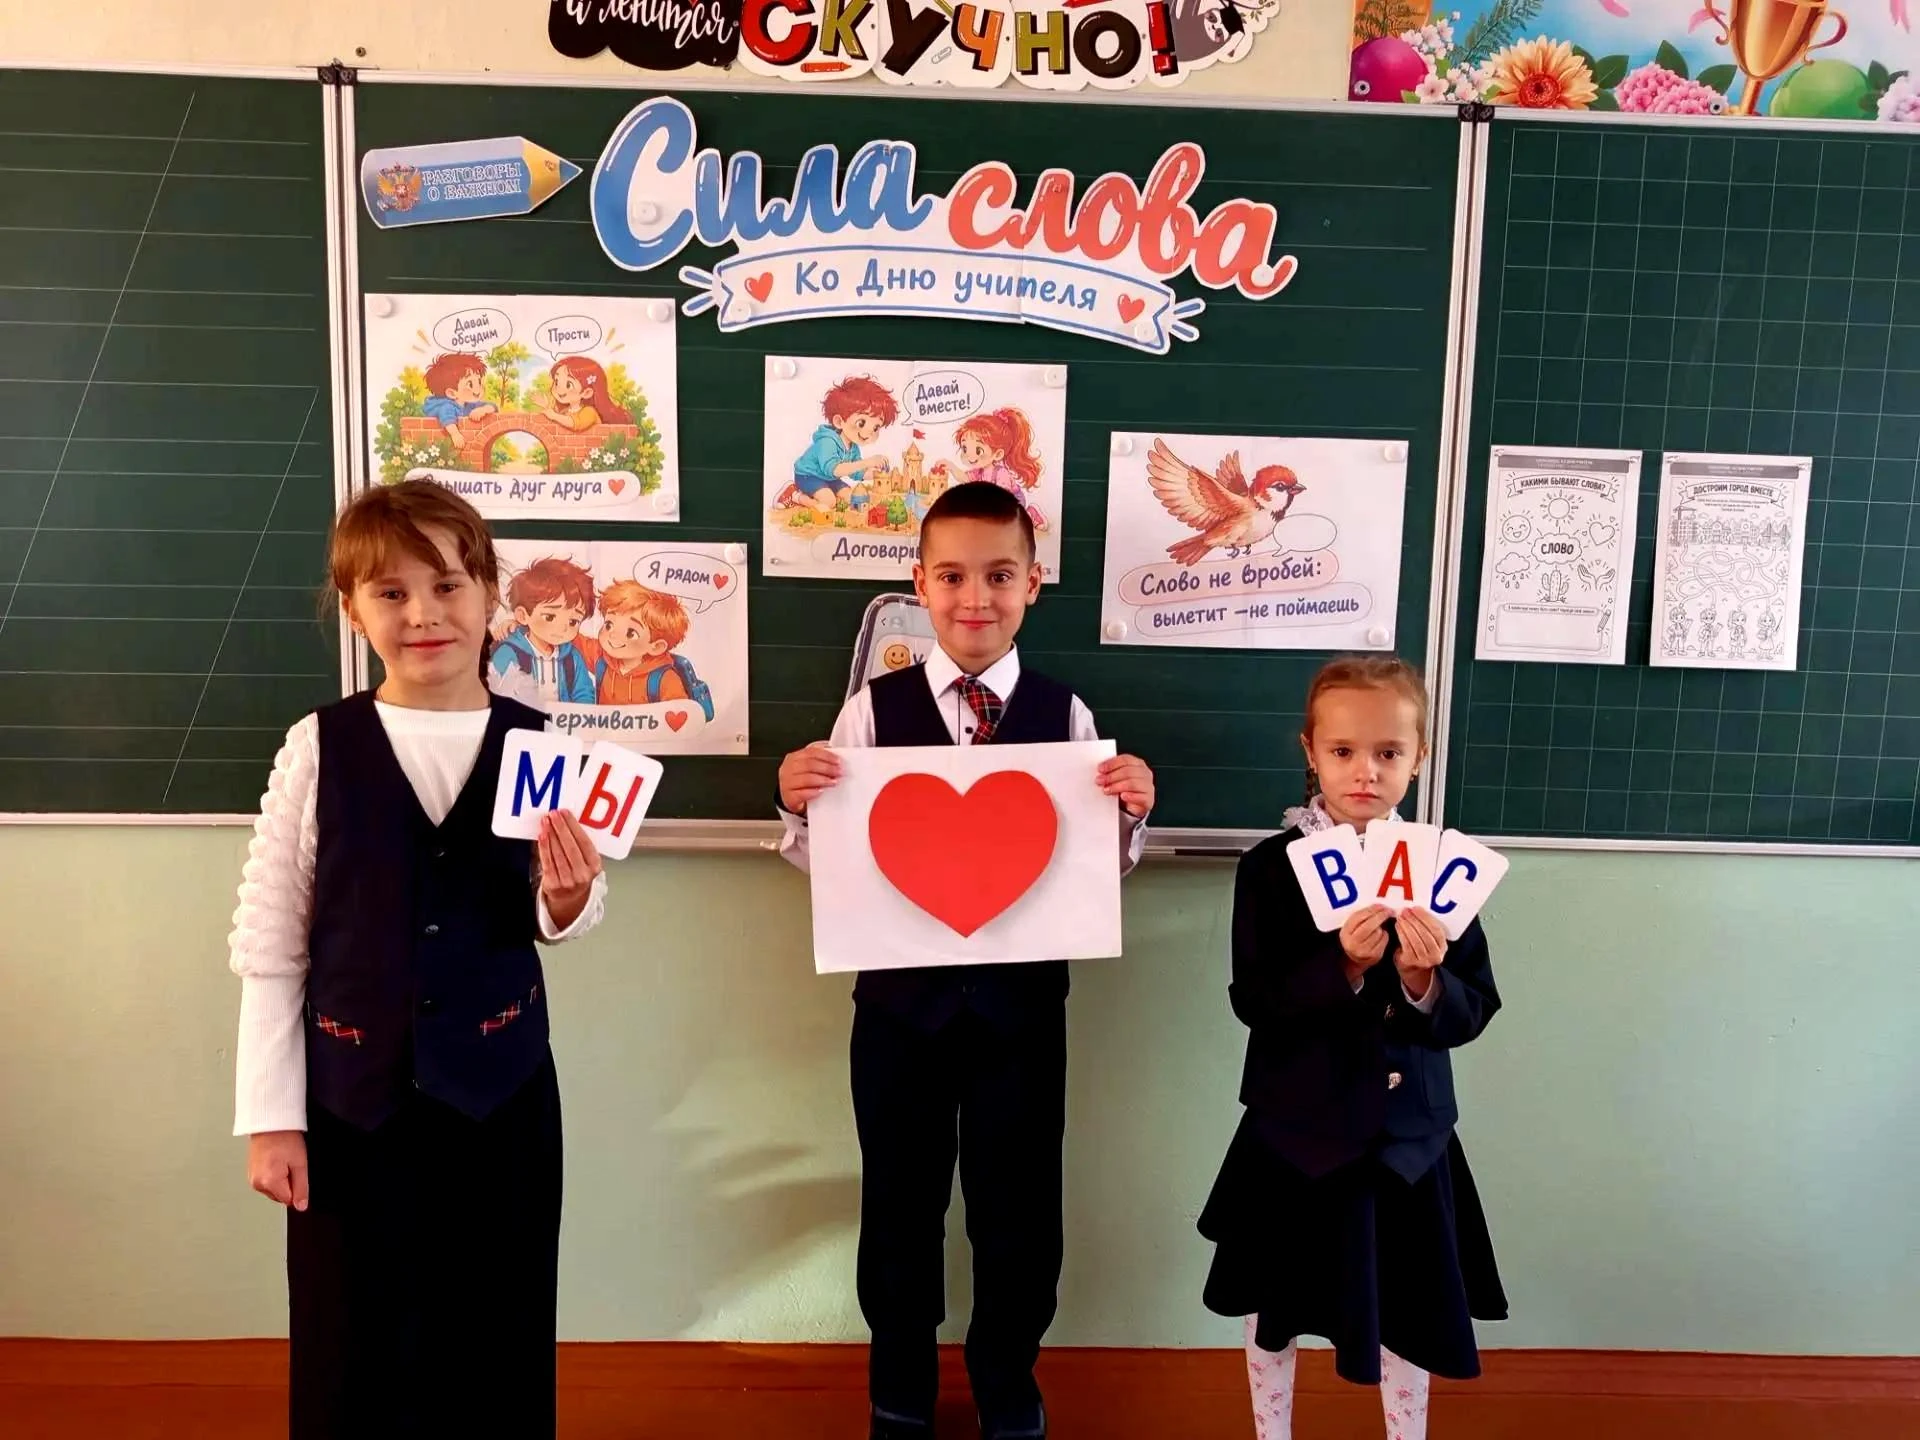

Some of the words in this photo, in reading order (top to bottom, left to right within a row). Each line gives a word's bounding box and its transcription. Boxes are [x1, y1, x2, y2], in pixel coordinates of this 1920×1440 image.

[740, 0, 1177, 77] СКУЧНО!
[423, 162, 521, 185] РАЗГОВОРЫ
[428, 187, 440, 201] О
[444, 178, 522, 200] ВАЖНОМ
[594, 99, 931, 268] Сила
[948, 143, 1297, 298] слова
[796, 261, 839, 295] Ко
[855, 263, 937, 296] Дню
[955, 269, 1098, 312] учителя
[454, 314, 490, 333] Давай
[451, 328, 498, 348] обсудим
[548, 327, 591, 345] Прости
[916, 380, 960, 402] Давай
[919, 393, 971, 417] вместе!
[423, 474, 502, 495] ышать
[510, 478, 547, 502] друг
[552, 478, 602, 502] друга
[1520, 477, 1549, 488] КАКИМИ
[1551, 477, 1580, 487] БЫВАЮТ
[1581, 479, 1606, 491] СЛОВА?
[1693, 484, 1728, 495] ДОСТРОИМ
[1729, 484, 1749, 493] ГОРОД
[1751, 485, 1775, 497] ВМЕСТЕ
[1541, 543, 1574, 555] СЛОВО
[648, 561, 660, 579] Я
[665, 564, 710, 584] рядом
[1140, 572, 1200, 596] Слово
[1209, 570, 1232, 588] не
[1153, 605, 1228, 628] вылетит
[1275, 597, 1360, 617] поймаешь
[546, 710, 659, 736] ерживать
